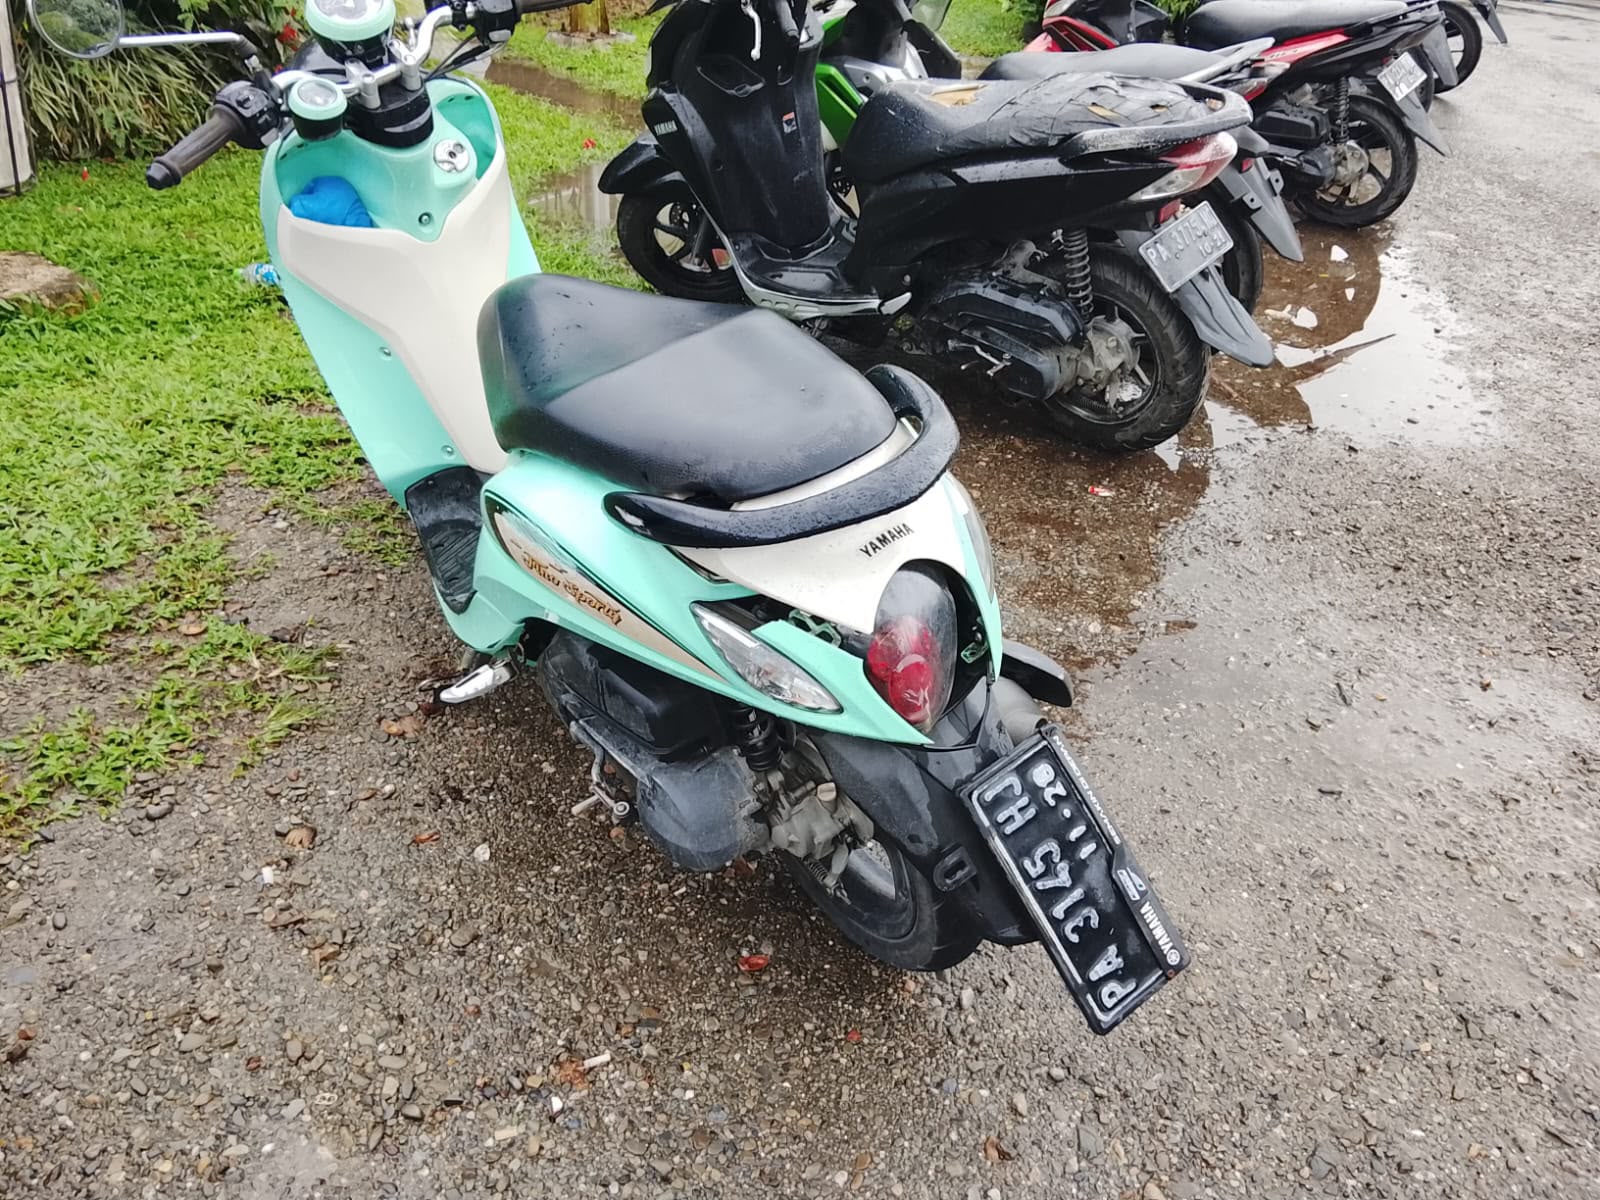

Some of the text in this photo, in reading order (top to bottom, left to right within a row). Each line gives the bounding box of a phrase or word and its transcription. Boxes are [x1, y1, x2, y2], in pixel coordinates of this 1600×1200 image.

[654, 120, 678, 136] YAMAHA
[1146, 241, 1171, 266] PA
[859, 523, 914, 557] YAMAHA
[984, 777, 1036, 834] HJ
[1079, 776, 1089, 790] DI
[1087, 788, 1121, 845] SEMAKIN
[1023, 842, 1099, 943] 3145
[1140, 901, 1174, 955] YAMAHA
[1089, 944, 1136, 1009] PA
